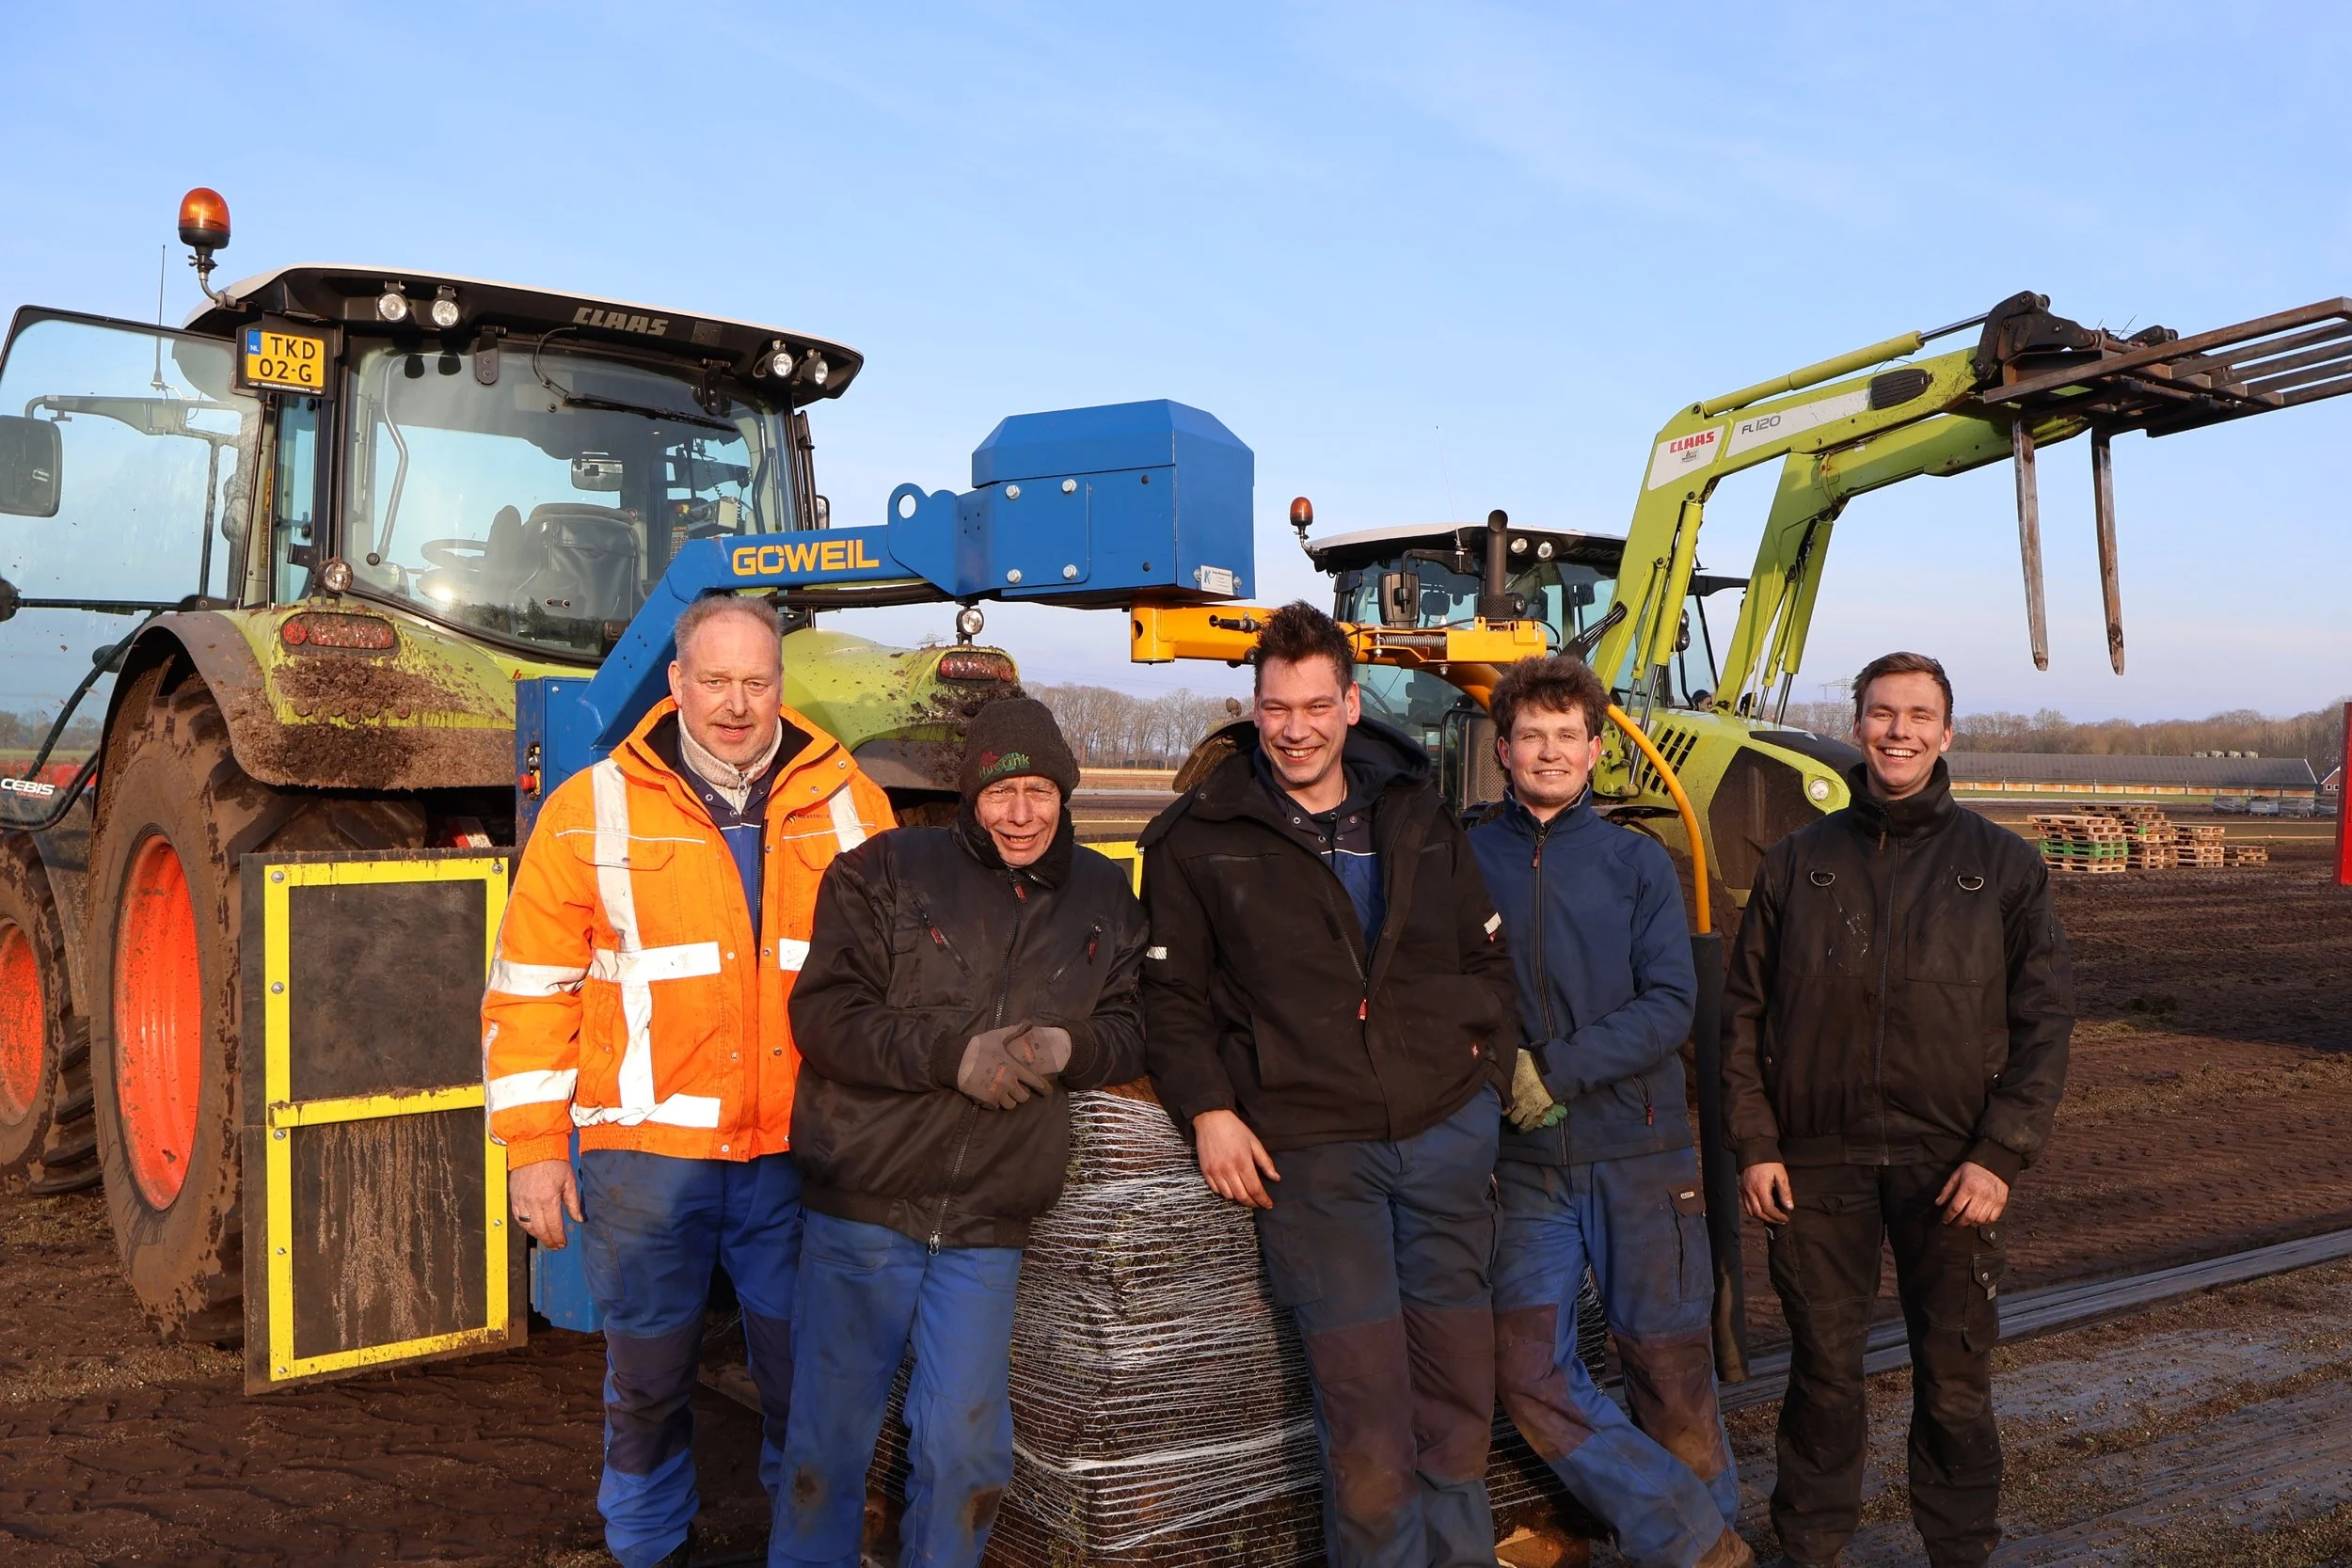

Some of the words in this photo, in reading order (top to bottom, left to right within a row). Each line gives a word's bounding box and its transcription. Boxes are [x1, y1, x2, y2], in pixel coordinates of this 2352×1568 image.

[572, 307, 670, 337] CLAAS
[249, 344, 260, 353] NL
[270, 336, 316, 360] TKD
[259, 357, 312, 383] 02-G
[1669, 431, 1715, 454] CLAAS
[0, 777, 56, 796] CEBIS
